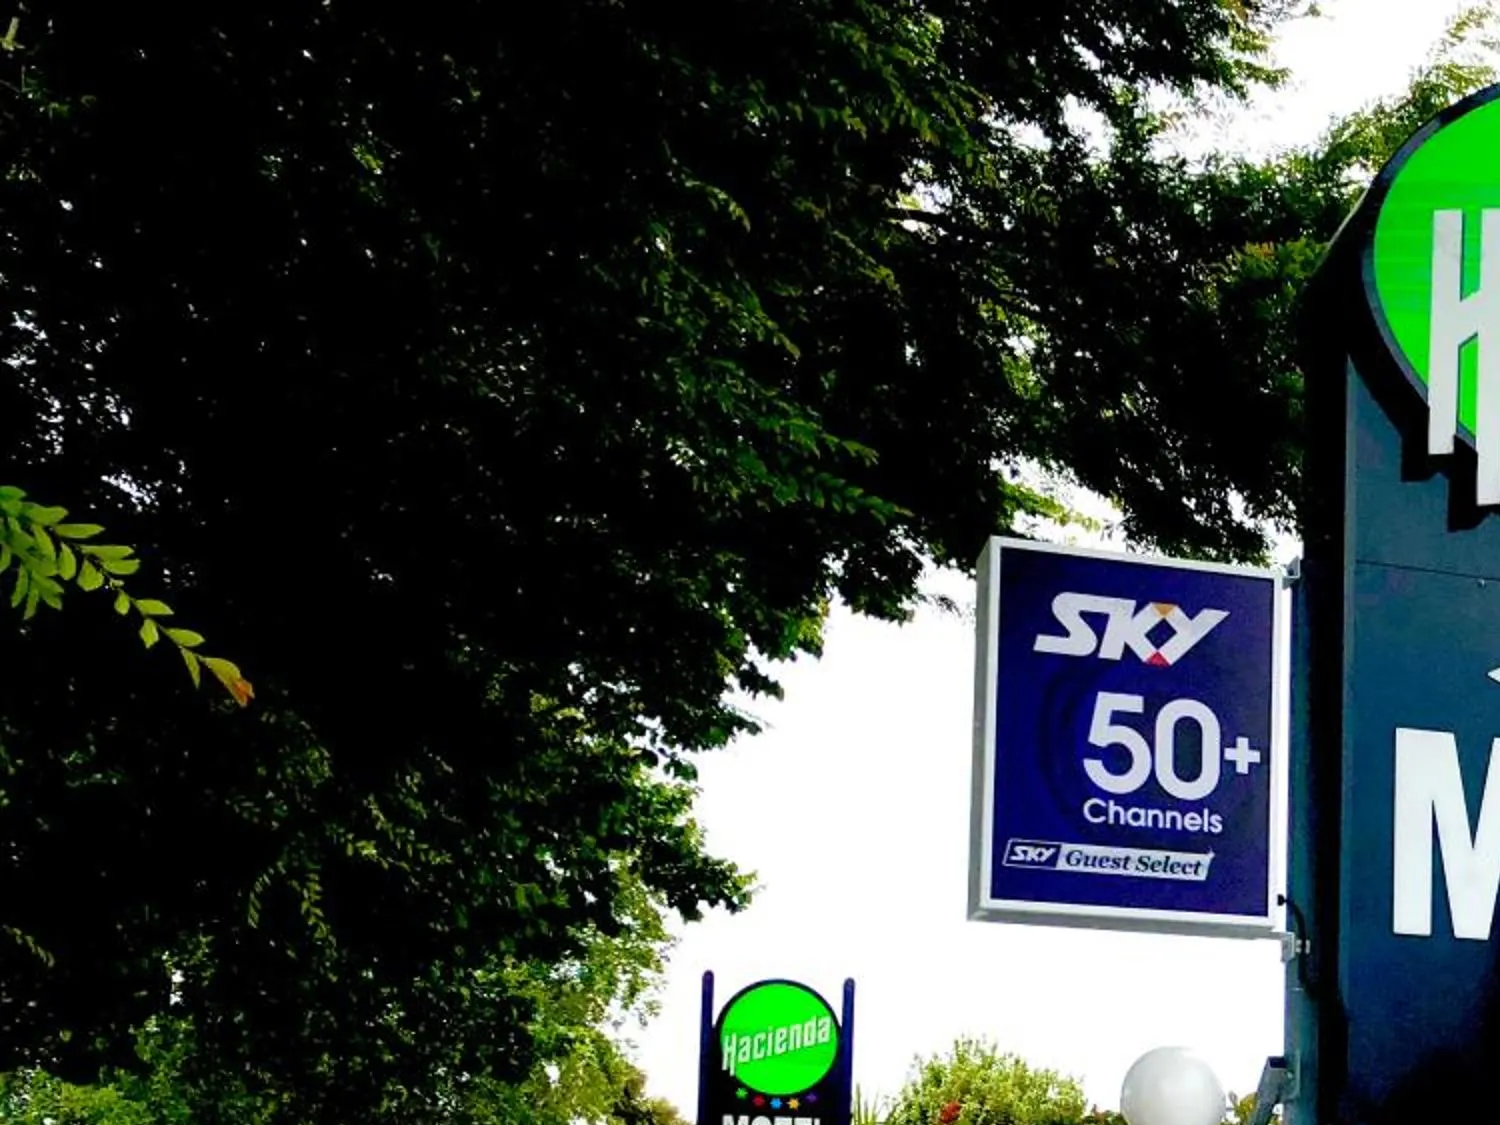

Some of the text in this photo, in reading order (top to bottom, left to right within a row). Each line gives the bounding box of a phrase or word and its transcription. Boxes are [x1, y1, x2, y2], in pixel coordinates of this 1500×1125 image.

[1033, 591, 1232, 666] SKY
[1083, 690, 1261, 801] 50+
[1082, 797, 1224, 834] Channels
[1065, 849, 1131, 871] Guest
[1135, 854, 1202, 876] Select
[721, 1014, 832, 1076] Hacienda
